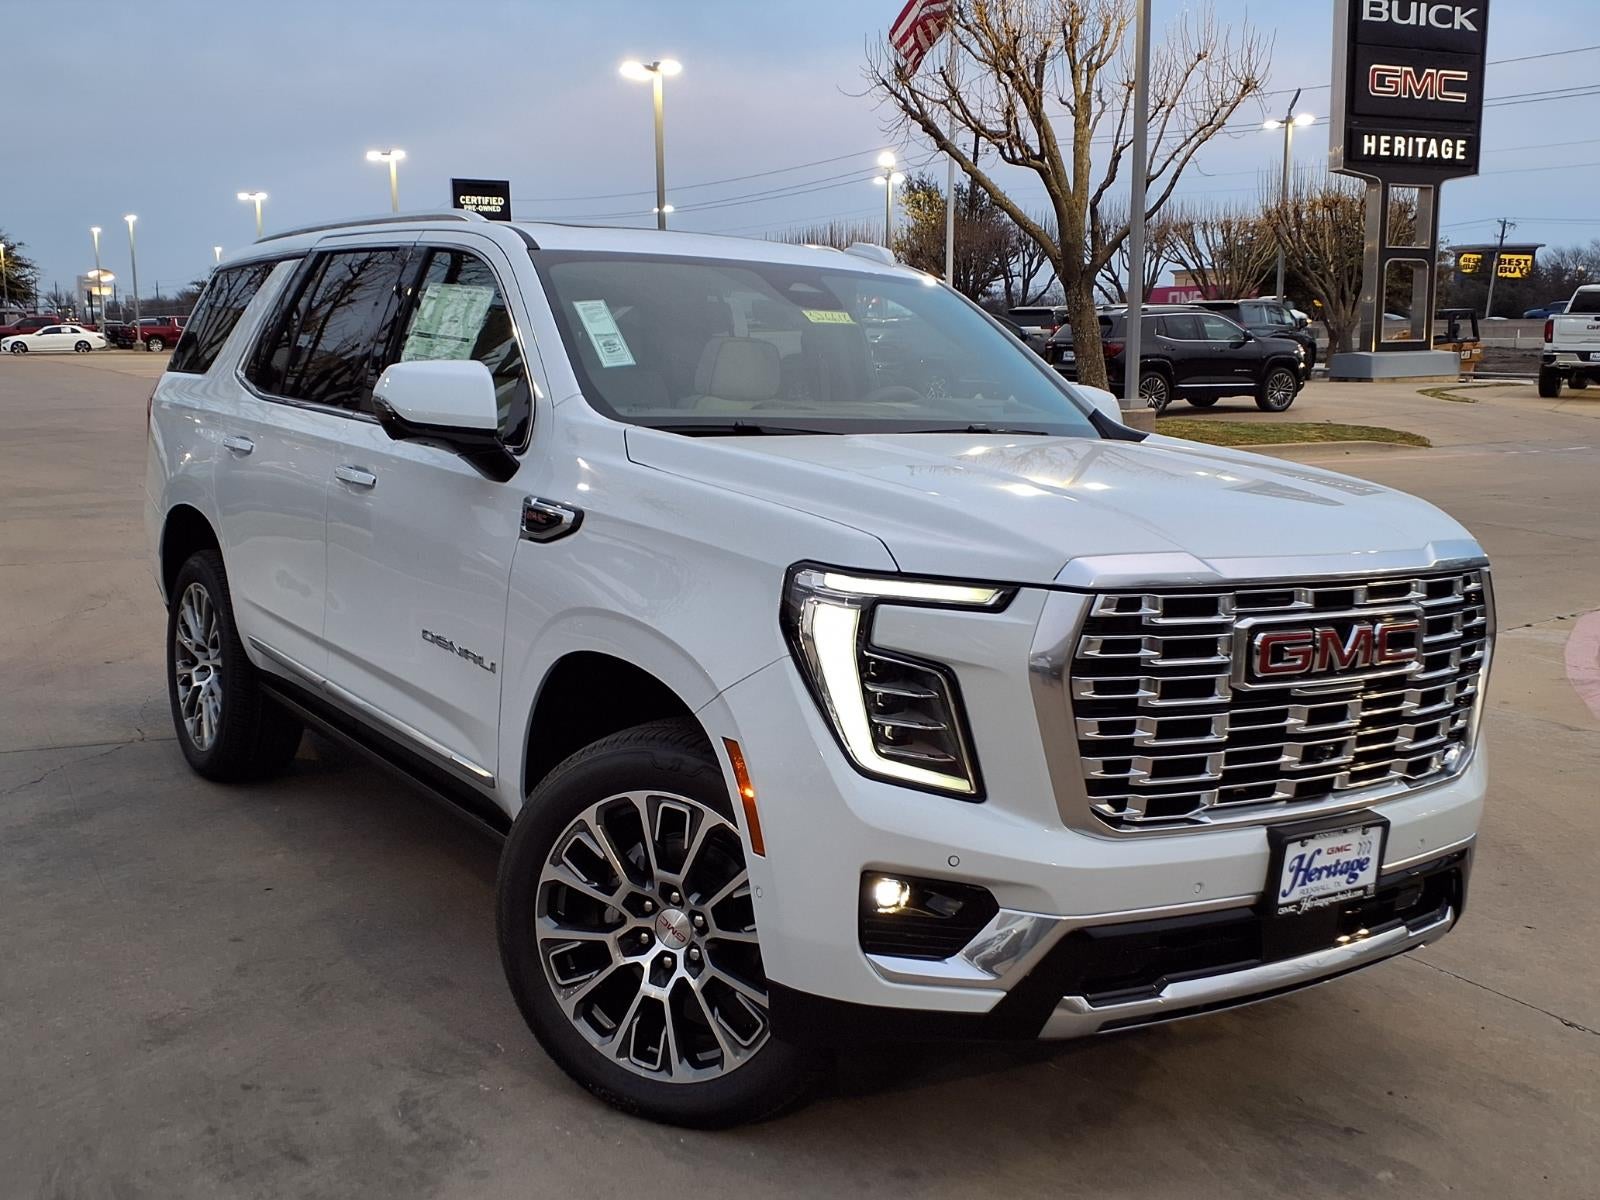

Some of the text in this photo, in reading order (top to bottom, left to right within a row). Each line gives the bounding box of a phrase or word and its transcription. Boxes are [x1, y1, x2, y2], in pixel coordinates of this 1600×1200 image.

[1362, 0, 1478, 31] BUICK
[1369, 64, 1468, 103] GMC
[1363, 134, 1467, 160] HERITAGE
[459, 195, 505, 206] CERTIFIED
[463, 205, 502, 213] PRE-OWNED
[1500, 258, 1530, 267] BEST
[1500, 266, 1526, 275] BUY
[422, 629, 497, 675] DENALI
[1254, 619, 1420, 678] GMC
[1326, 843, 1353, 855] GMC
[1281, 848, 1371, 898] Heritage
[1277, 904, 1298, 915] GMC
[659, 915, 687, 943] GMC
